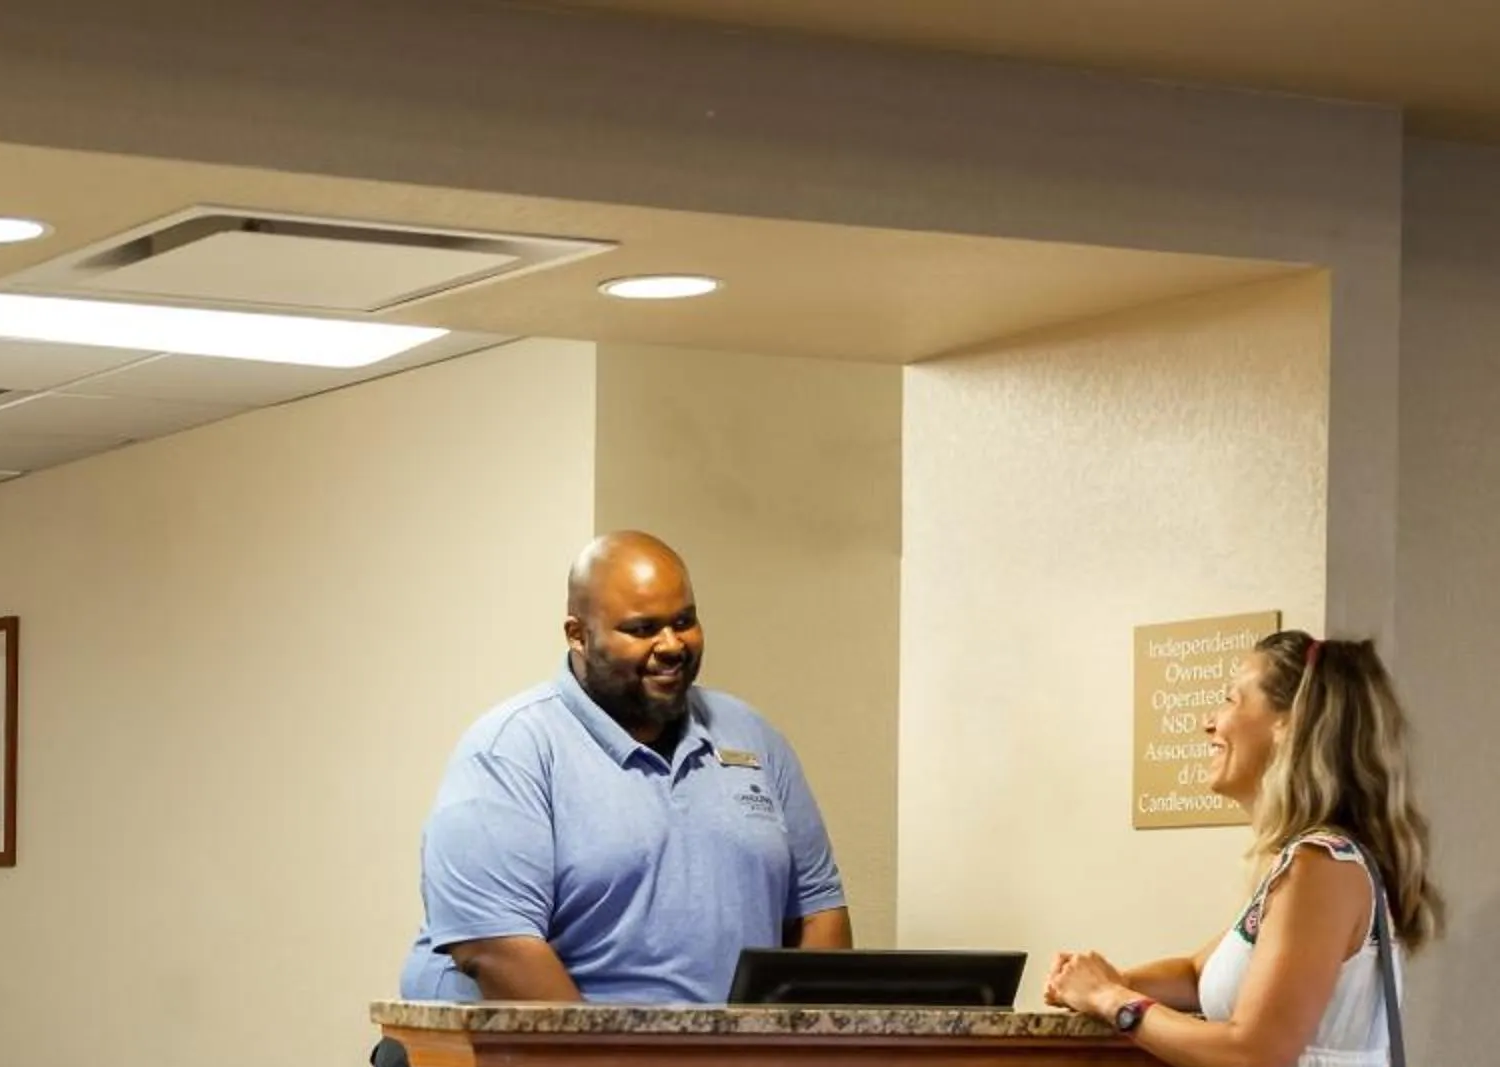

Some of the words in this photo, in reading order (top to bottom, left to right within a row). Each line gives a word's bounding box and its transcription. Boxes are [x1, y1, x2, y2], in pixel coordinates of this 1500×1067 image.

[1149, 630, 1259, 661] Independently
[1165, 658, 1223, 683] Owned
[1151, 683, 1228, 712] Operated
[1161, 713, 1197, 734] NSD
[1139, 791, 1223, 813] Candlewood
